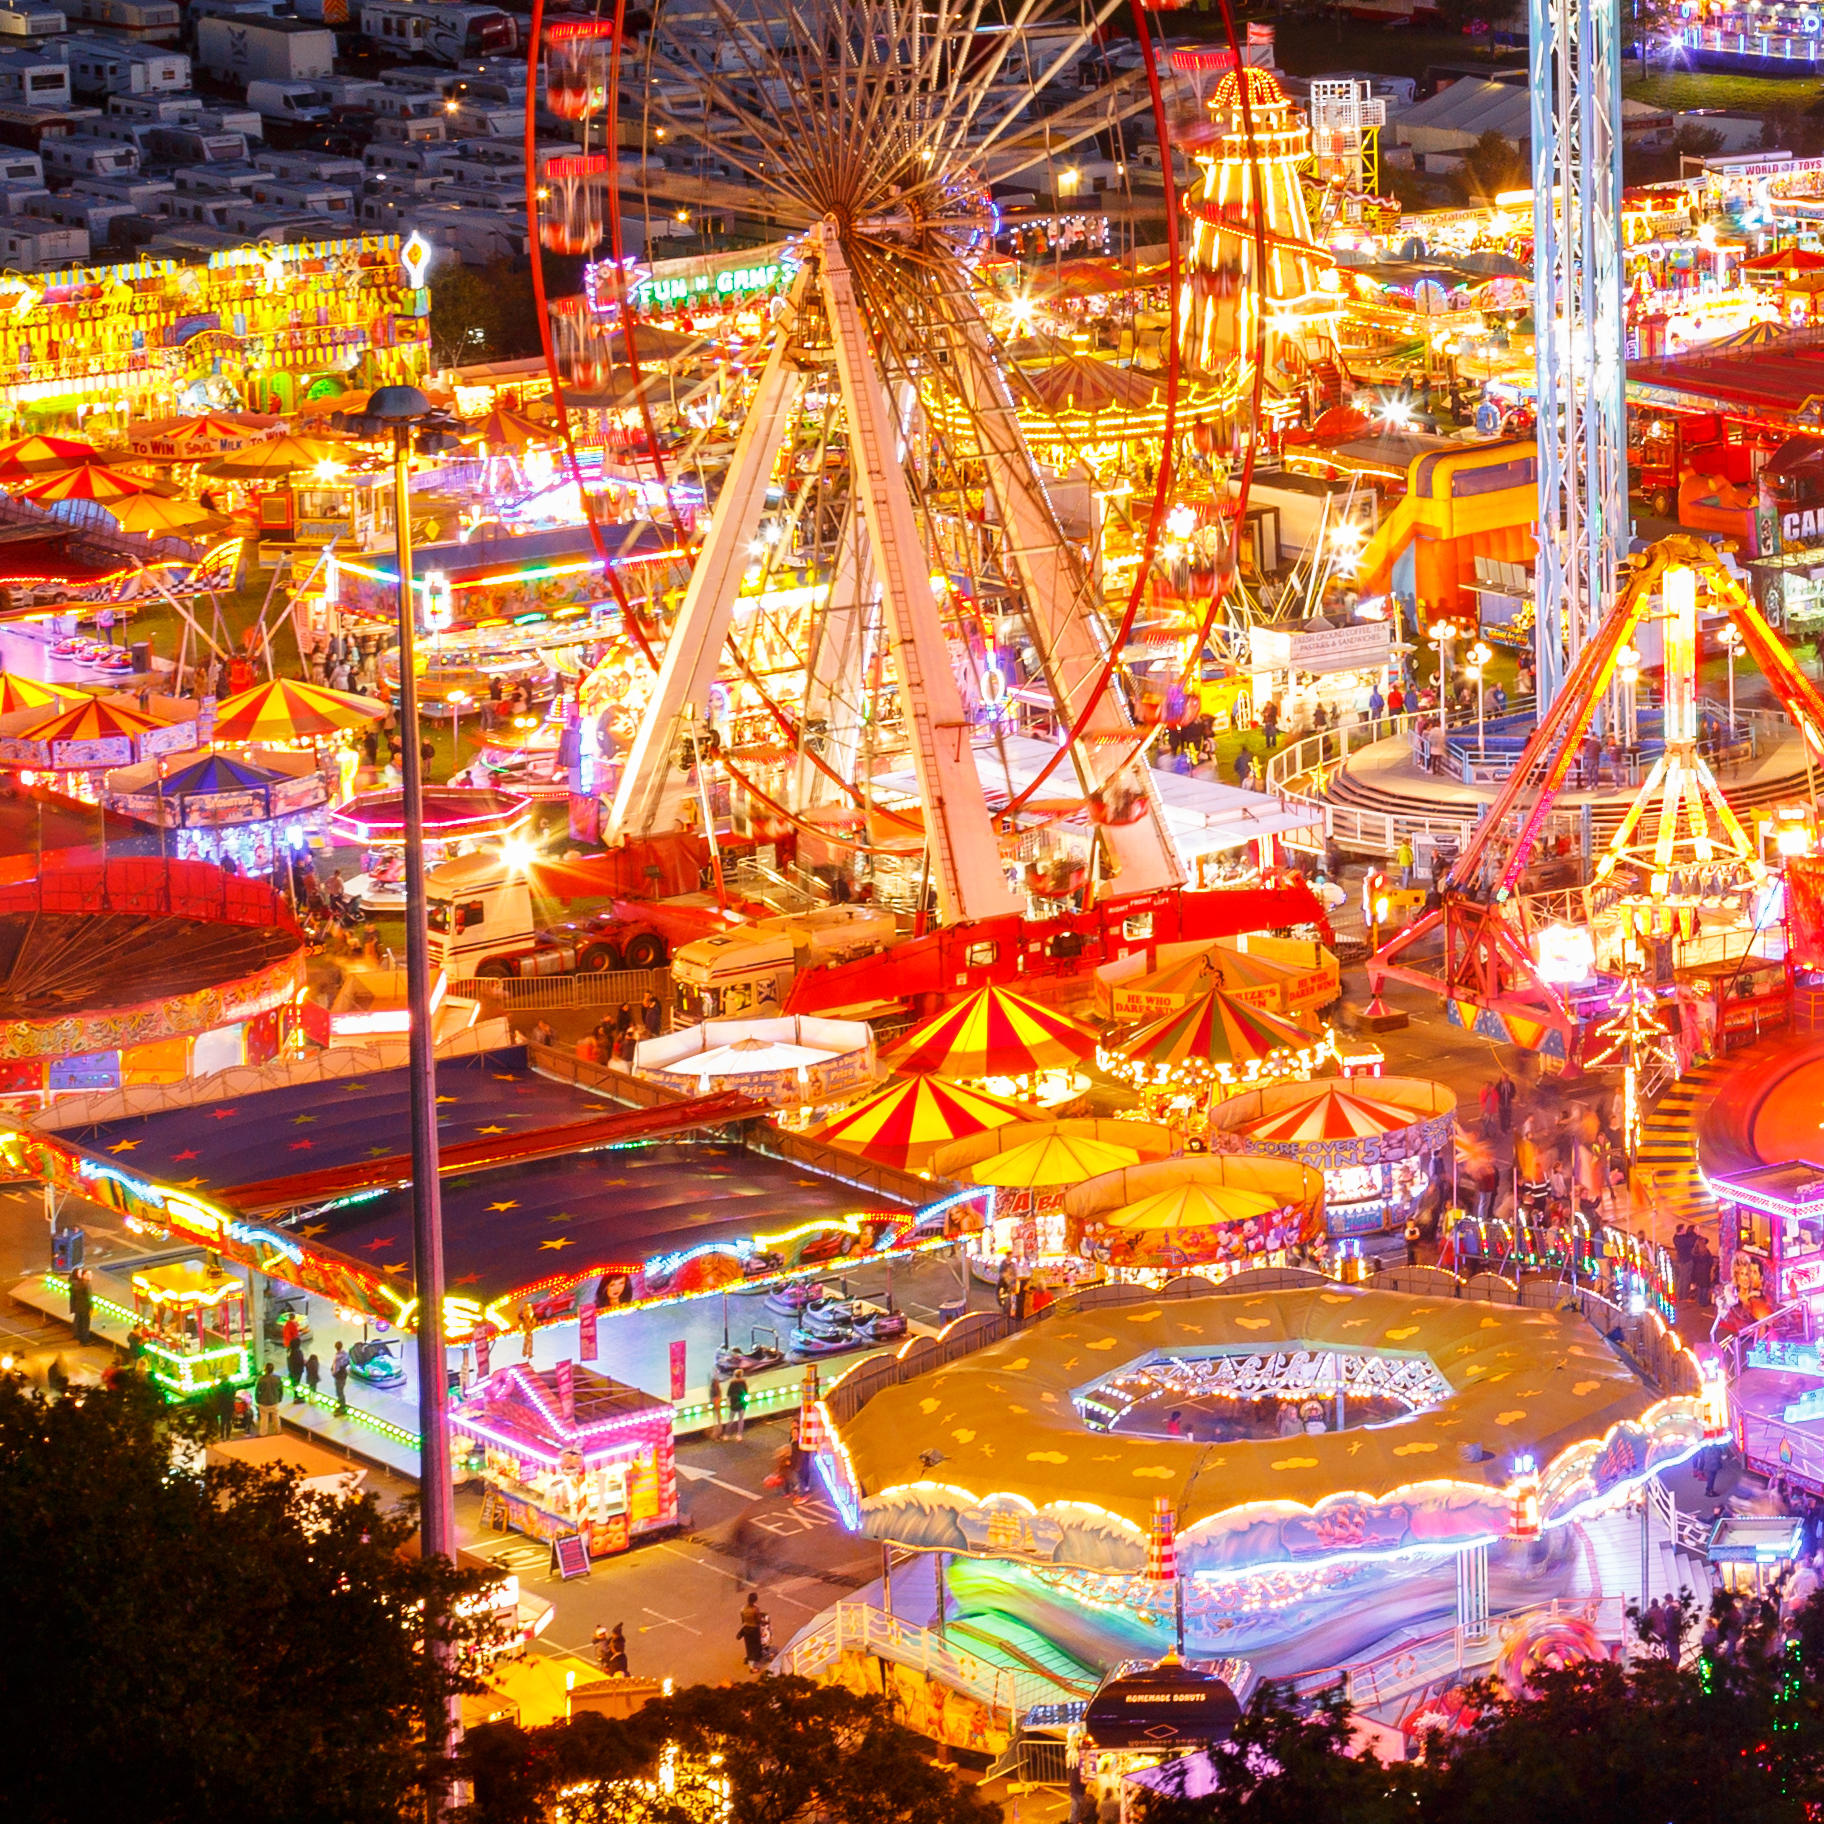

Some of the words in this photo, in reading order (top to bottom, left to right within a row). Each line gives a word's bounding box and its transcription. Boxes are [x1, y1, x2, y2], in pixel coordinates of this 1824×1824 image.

[1745, 163, 1779, 175] WORLD
[1781, 162, 1794, 172] OF
[1799, 159, 1822, 170] TOYS
[1414, 211, 1477, 225] PlayStation
[639, 278, 687, 304] FUN
[695, 276, 709, 291] N
[266, 429, 286, 440] WIN
[132, 442, 148, 454] TO
[149, 441, 174, 455] WIN
[1294, 635, 1315, 645] FRESH
[1316, 632, 1344, 642] GROUND
[1374, 624, 1386, 632] TEA
[1339, 634, 1381, 645] SANDWICHES
[1108, 904, 1129, 914] RIGHT
[1130, 897, 1152, 907] FRONT
[1153, 897, 1169, 906] LEFT
[1310, 972, 1328, 983] WHO
[1127, 994, 1142, 1004] HE
[1145, 995, 1171, 1005] WHO
[1235, 988, 1276, 1000] RIZE'S
[740, 1085, 773, 1095] Prize
[1246, 1138, 1299, 1154] SCORE
[1307, 1139, 1358, 1154] OVER
[1363, 1135, 1382, 1164] 5
[1009, 1191, 1032, 1214] A
[1126, 1693, 1172, 1703] HOMEMADE
[1173, 1693, 1206, 1702] DONUTS
